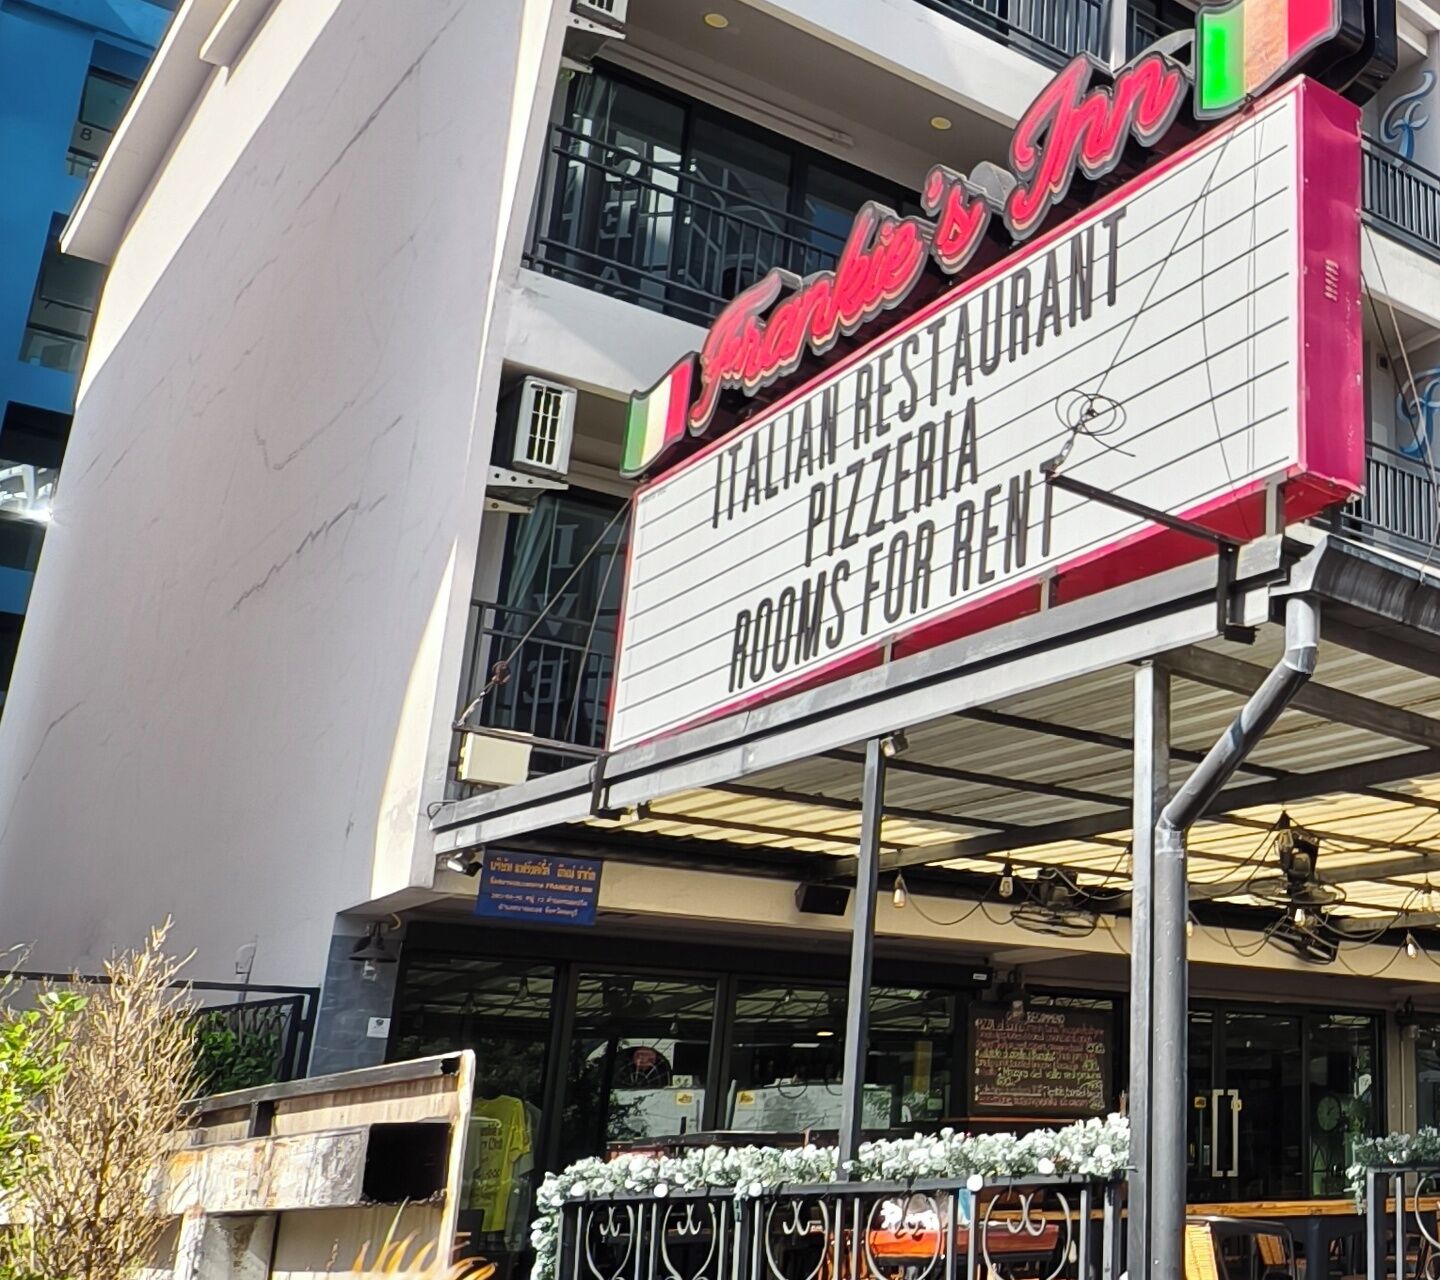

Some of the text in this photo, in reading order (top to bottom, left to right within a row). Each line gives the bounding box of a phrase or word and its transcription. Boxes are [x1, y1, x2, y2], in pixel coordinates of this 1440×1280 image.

[689, 166, 989, 434] Frankie's
[1006, 50, 1188, 239] Inn
[710, 387, 842, 529] ITALIAN
[851, 207, 1128, 451] RESTAURANT
[727, 457, 1060, 694] ROOMS FOR RENT
[803, 396, 979, 568] PIZZERIA
